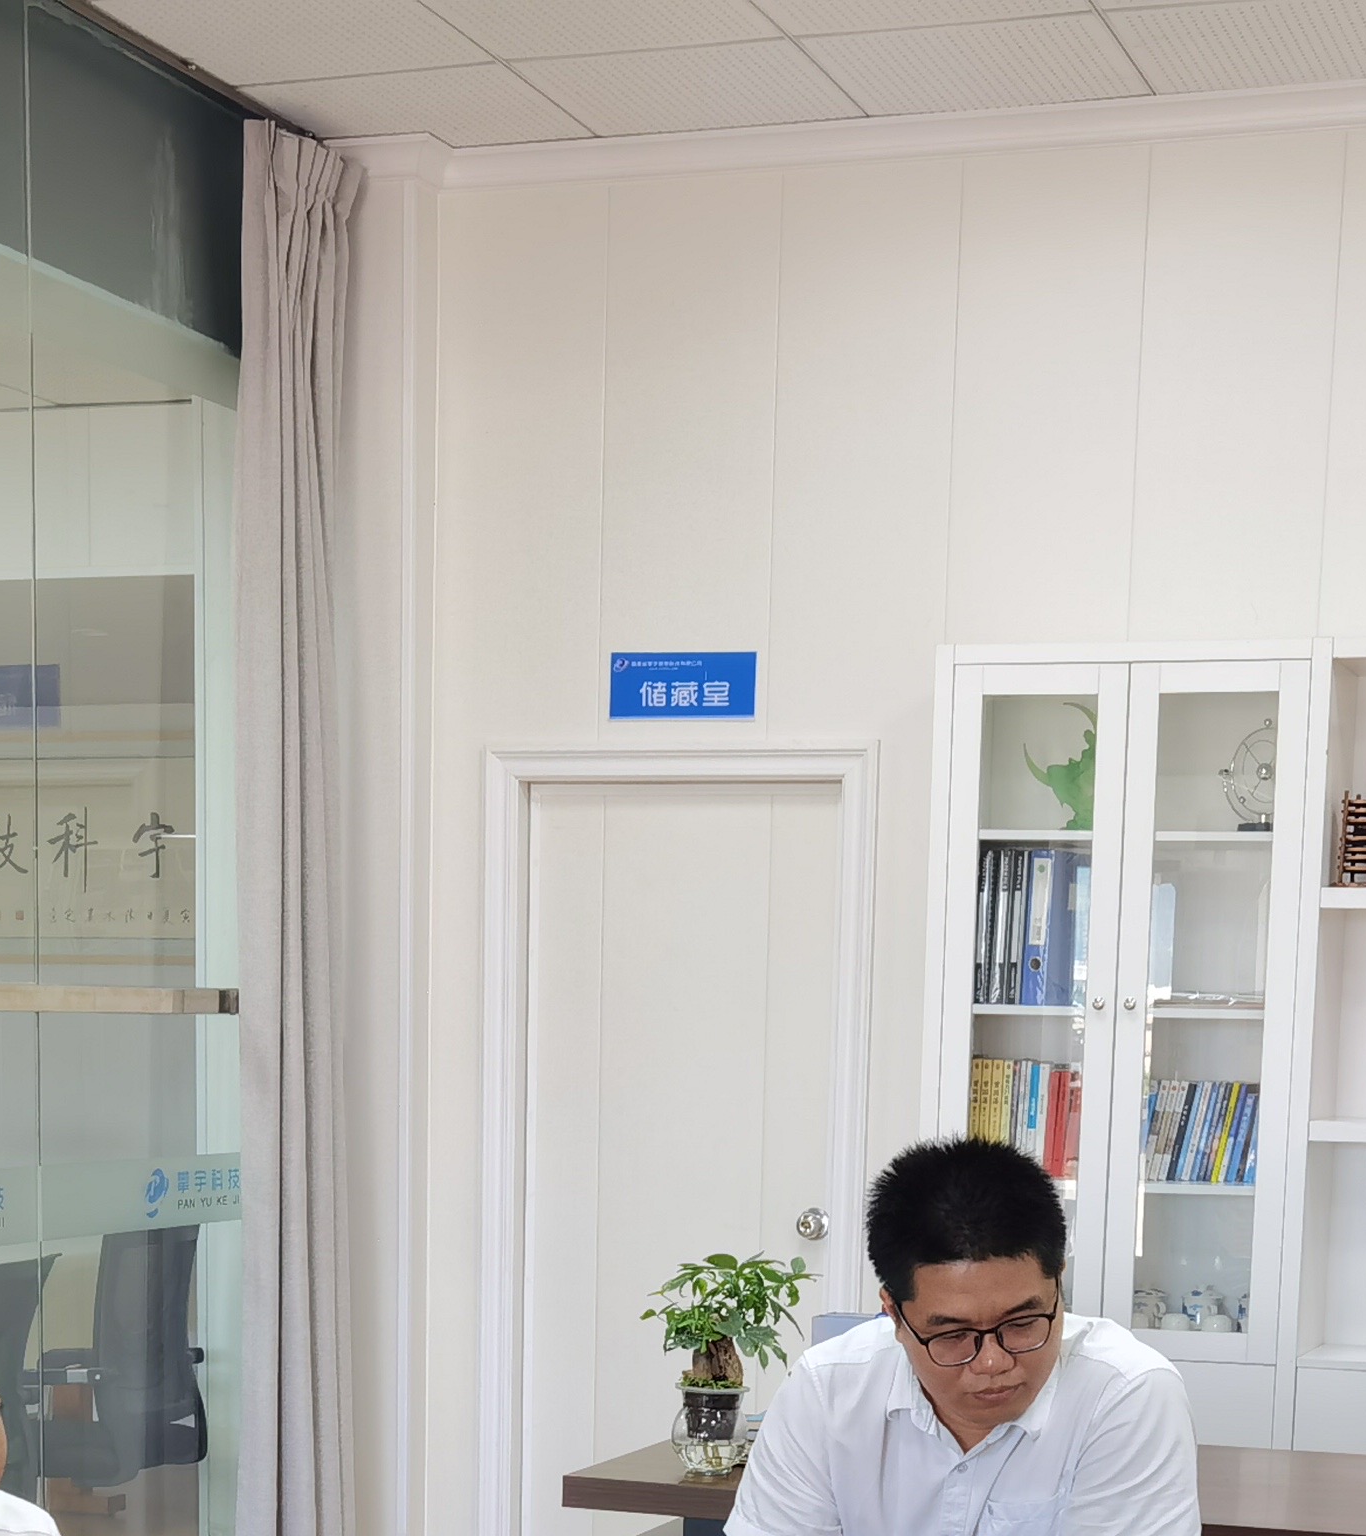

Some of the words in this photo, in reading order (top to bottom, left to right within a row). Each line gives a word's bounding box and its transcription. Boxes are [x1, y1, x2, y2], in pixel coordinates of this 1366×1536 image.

[639, 681, 730, 707] 储藏室
[178, 1199, 195, 1210] PAN
[201, 1197, 212, 1208] YU
[217, 1195, 228, 1206] KE
